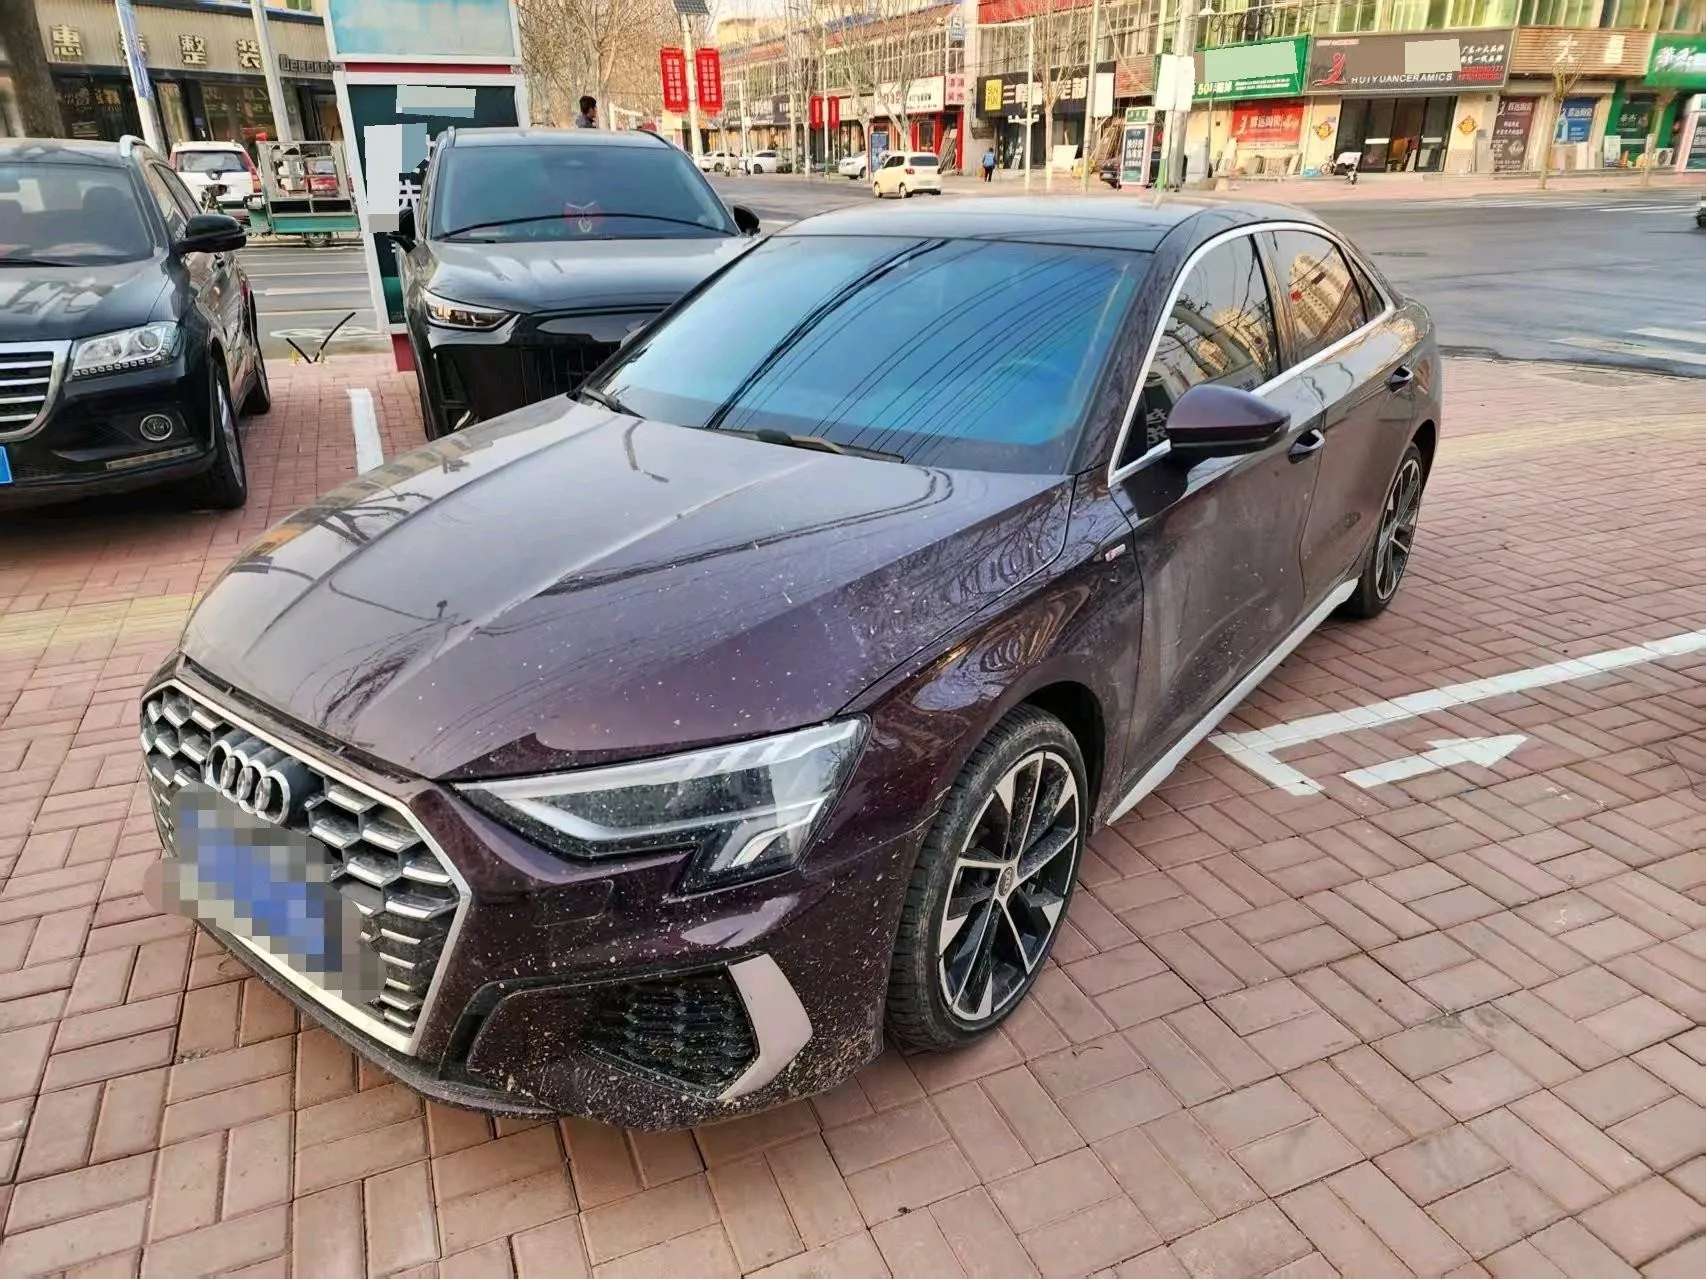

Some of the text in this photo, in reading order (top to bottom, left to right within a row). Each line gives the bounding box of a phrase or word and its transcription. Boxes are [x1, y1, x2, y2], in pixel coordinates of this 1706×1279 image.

[52, 23, 263, 69] 惠整装
[1351, 73, 1453, 83] HUIYUANCERAMICS
